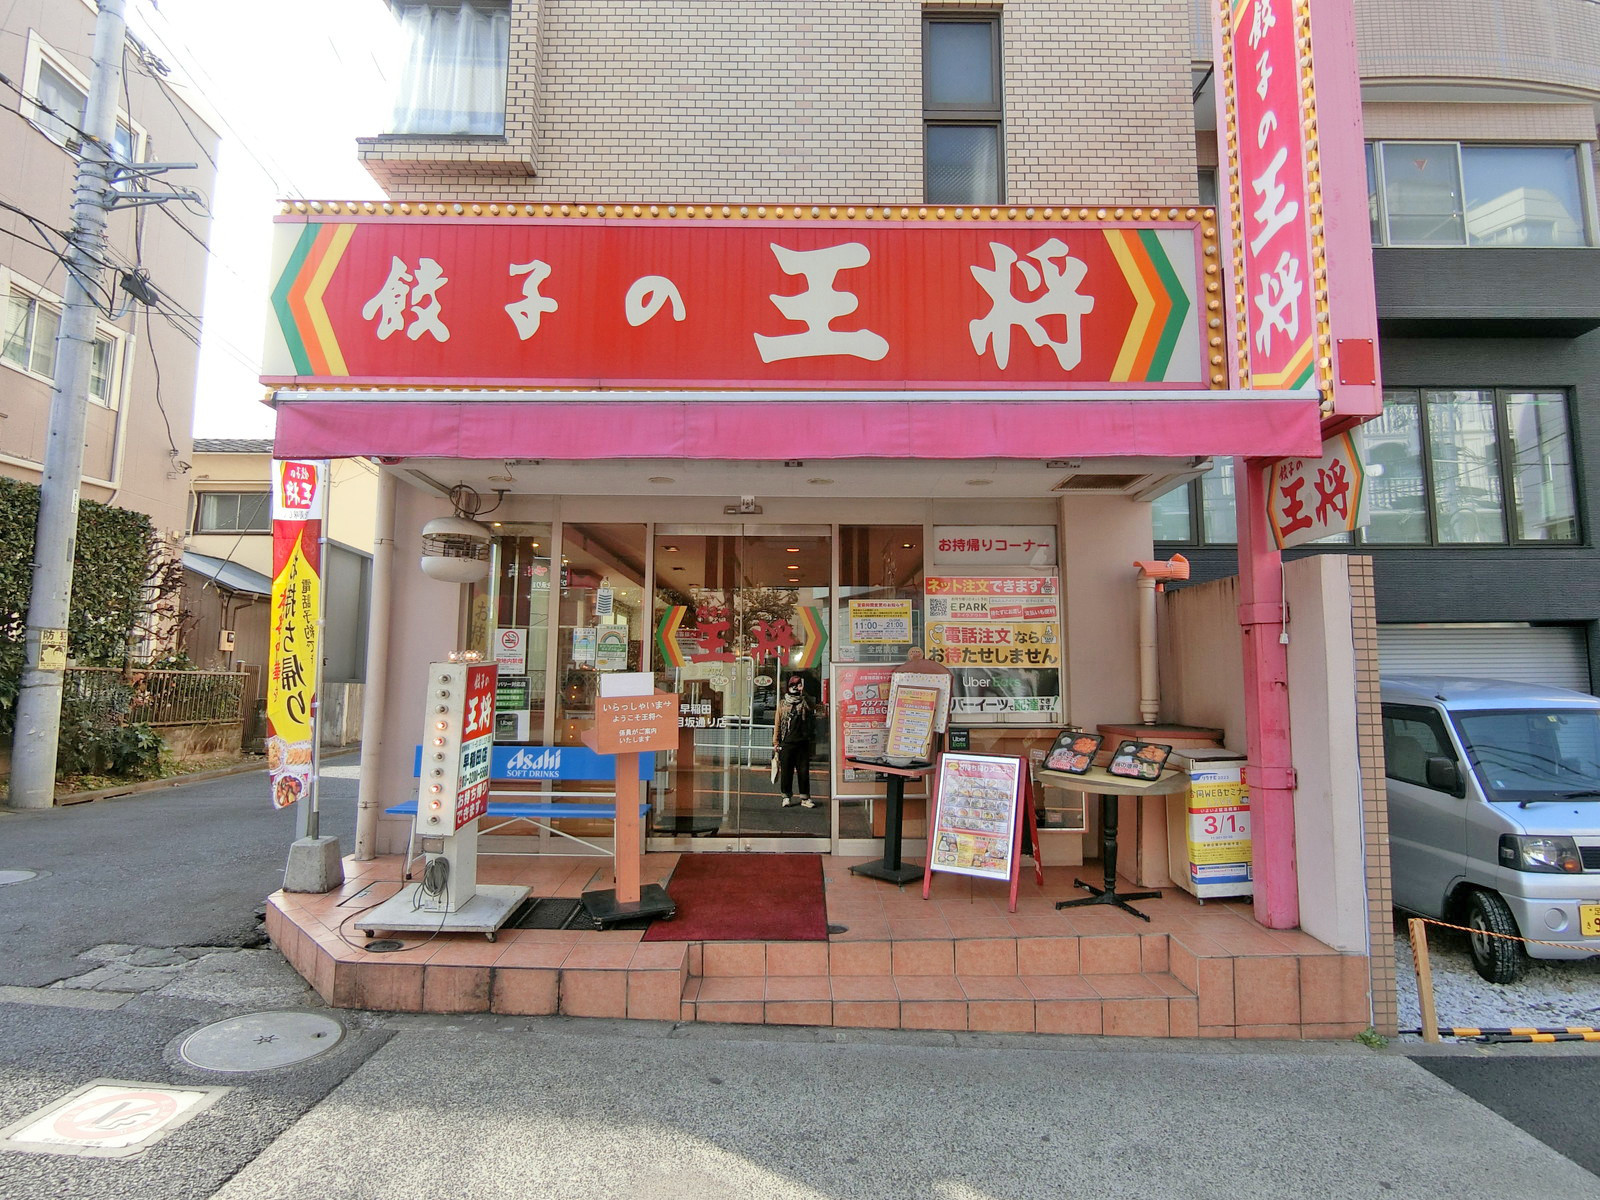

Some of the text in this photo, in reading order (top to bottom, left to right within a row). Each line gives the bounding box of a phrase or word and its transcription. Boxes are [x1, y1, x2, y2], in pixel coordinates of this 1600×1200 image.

[1248, 0, 1303, 358] 餃子の王将
[362, 238, 1095, 371] 餃子の王将
[1279, 460, 1303, 481] 餃子の
[1279, 458, 1350, 538] 王将
[938, 538, 1050, 552] お持帰りコーナー
[927, 579, 1041, 593] ネット注文できます
[855, 621, 878, 630] 11:00
[691, 618, 796, 667] 王将
[944, 626, 1040, 645] 電話注文なら
[929, 647, 1058, 664] お待たせしません
[962, 676, 991, 687] Uber
[465, 691, 493, 735] 王将
[680, 703, 712, 715] 早稲田
[612, 713, 663, 723] ようこそ王将へ
[619, 727, 657, 737] 係員がご案内
[619, 735, 651, 744] いたします
[507, 748, 561, 770] Asahi
[506, 769, 560, 778] SOFT DRINKS
[1204, 814, 1237, 835] 3/1
